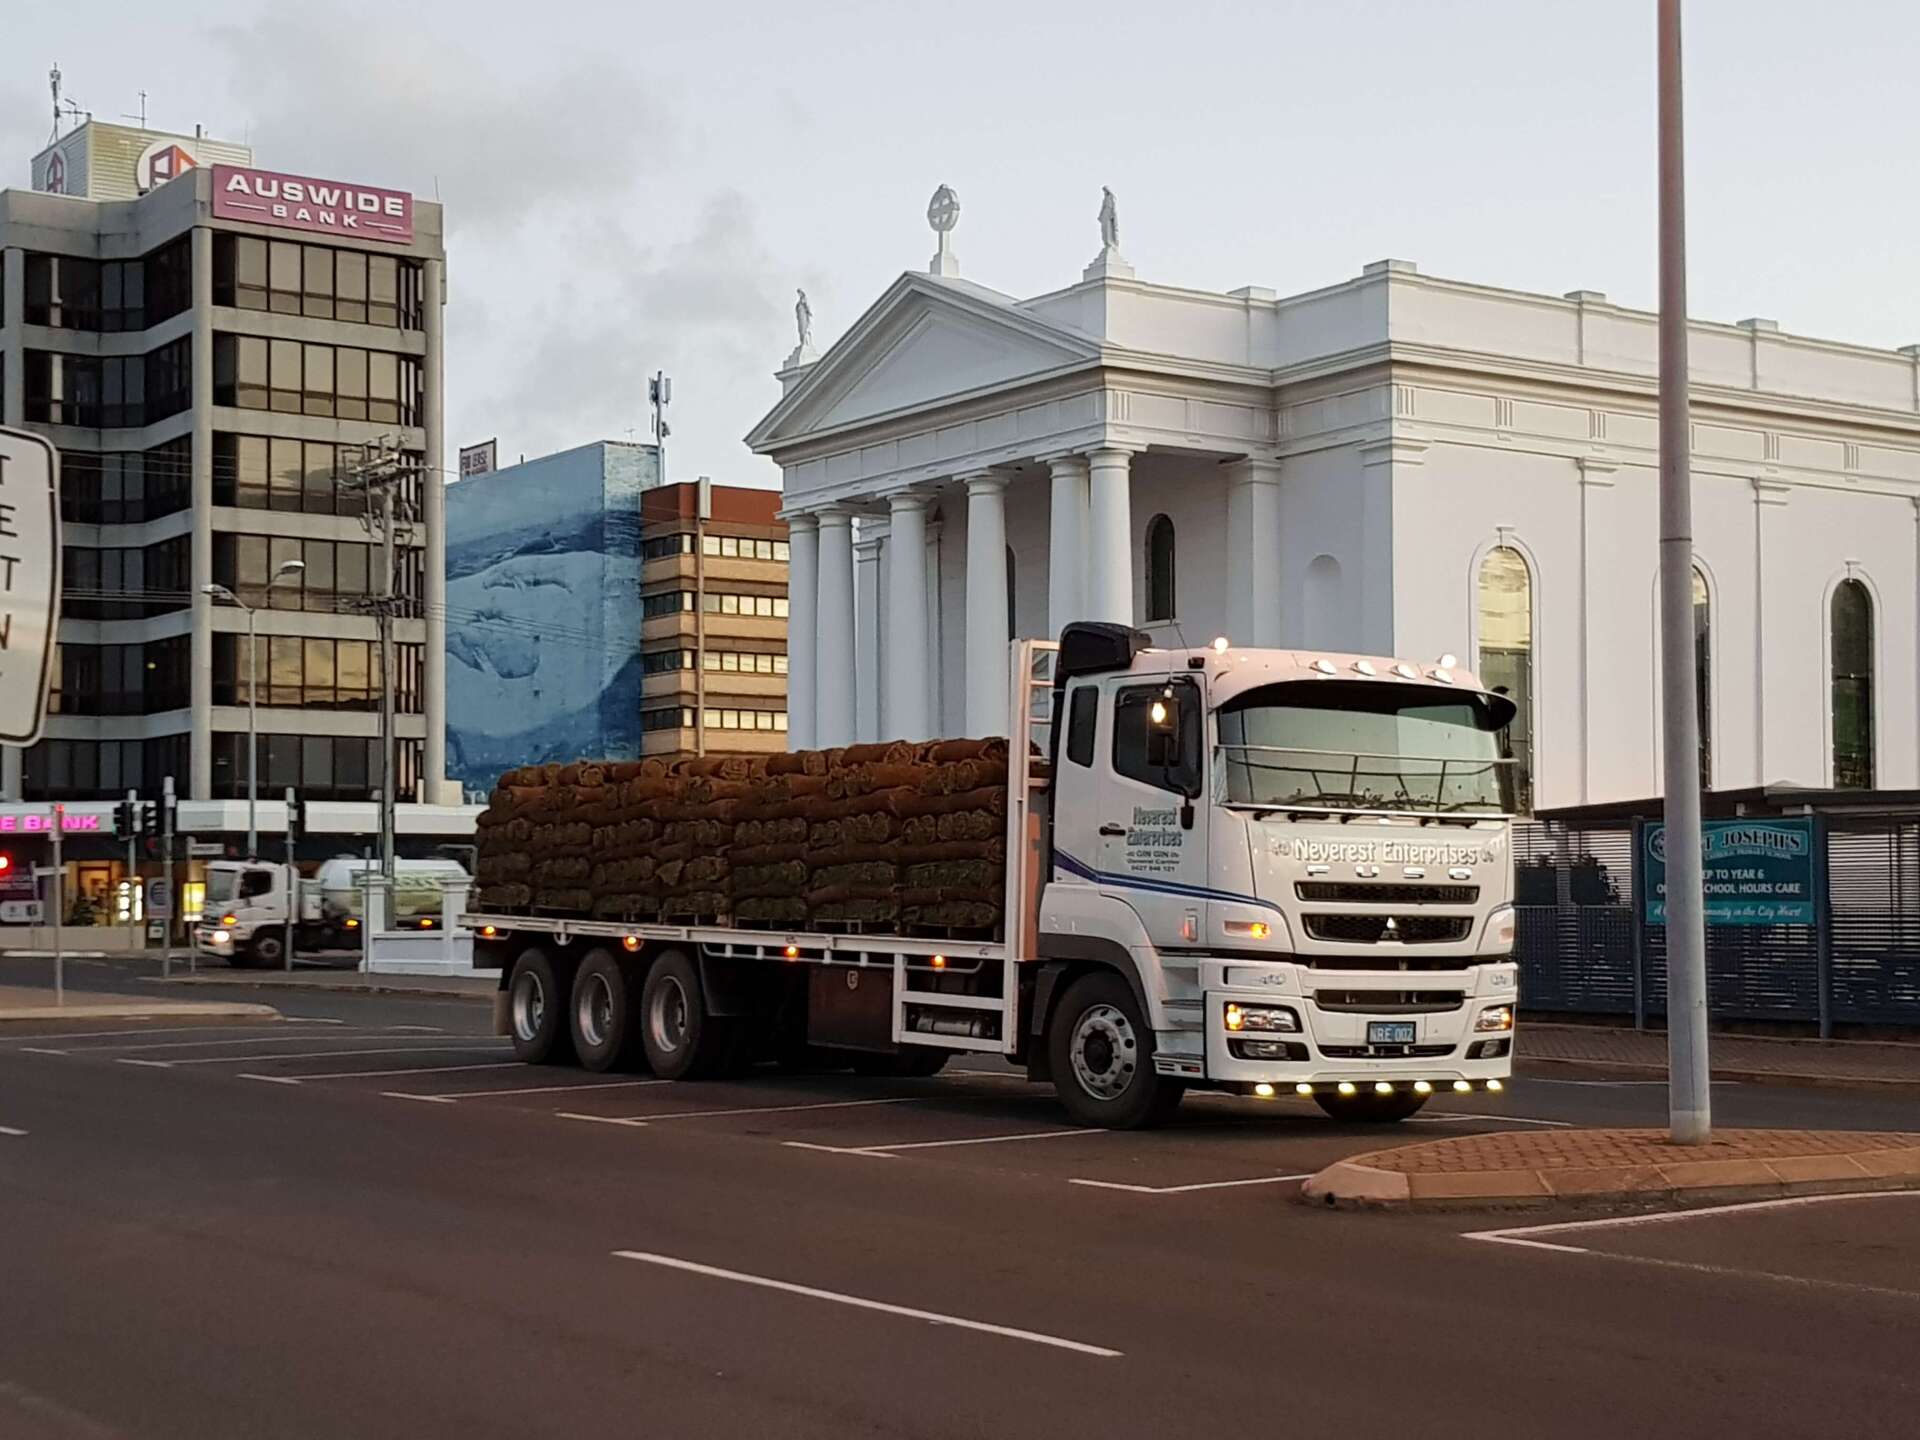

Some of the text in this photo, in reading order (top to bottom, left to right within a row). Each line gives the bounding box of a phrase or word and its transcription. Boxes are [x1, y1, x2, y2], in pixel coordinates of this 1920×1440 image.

[225, 173, 404, 217] AUSWIDE
[271, 204, 358, 228] BANK
[1721, 829, 1802, 851] JOSEPH'S
[1294, 838, 1479, 866] Neverest Enterprises
[1306, 865, 1473, 881] FUSO
[1715, 869, 1729, 879] TO
[1731, 869, 1756, 879] YEAR
[1757, 869, 1765, 880] 6
[1703, 883, 1801, 894] CHOOL HOURS CARE
